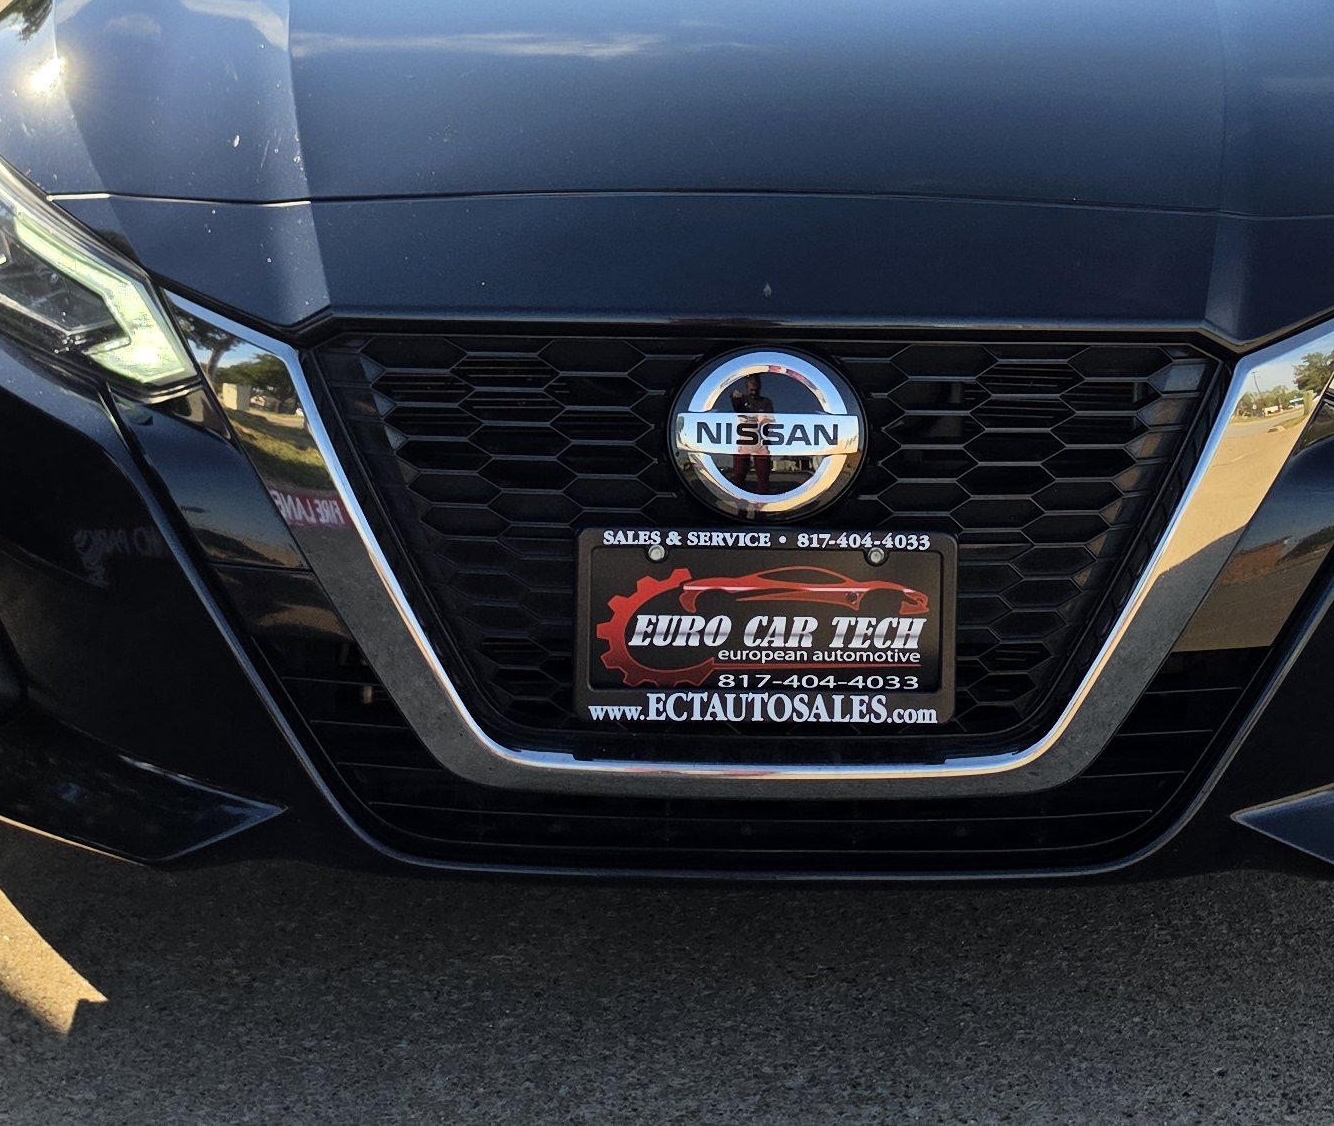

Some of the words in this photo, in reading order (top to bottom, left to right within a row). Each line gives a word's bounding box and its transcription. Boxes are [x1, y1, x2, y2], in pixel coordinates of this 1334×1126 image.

[696, 421, 839, 447] NISSAN
[602, 529, 662, 546] SALES
[665, 532, 682, 545] &
[686, 531, 771, 547] SERVICE
[797, 533, 931, 550] 817-404-4033
[628, 614, 732, 647] EURO
[743, 615, 818, 648] CAR
[830, 616, 927, 648] TECH
[717, 648, 808, 664] european
[812, 648, 921, 663] automotive
[717, 674, 919, 690] 817-404-4033
[588, 692, 938, 724] www.ECTAUTOSALES.com
